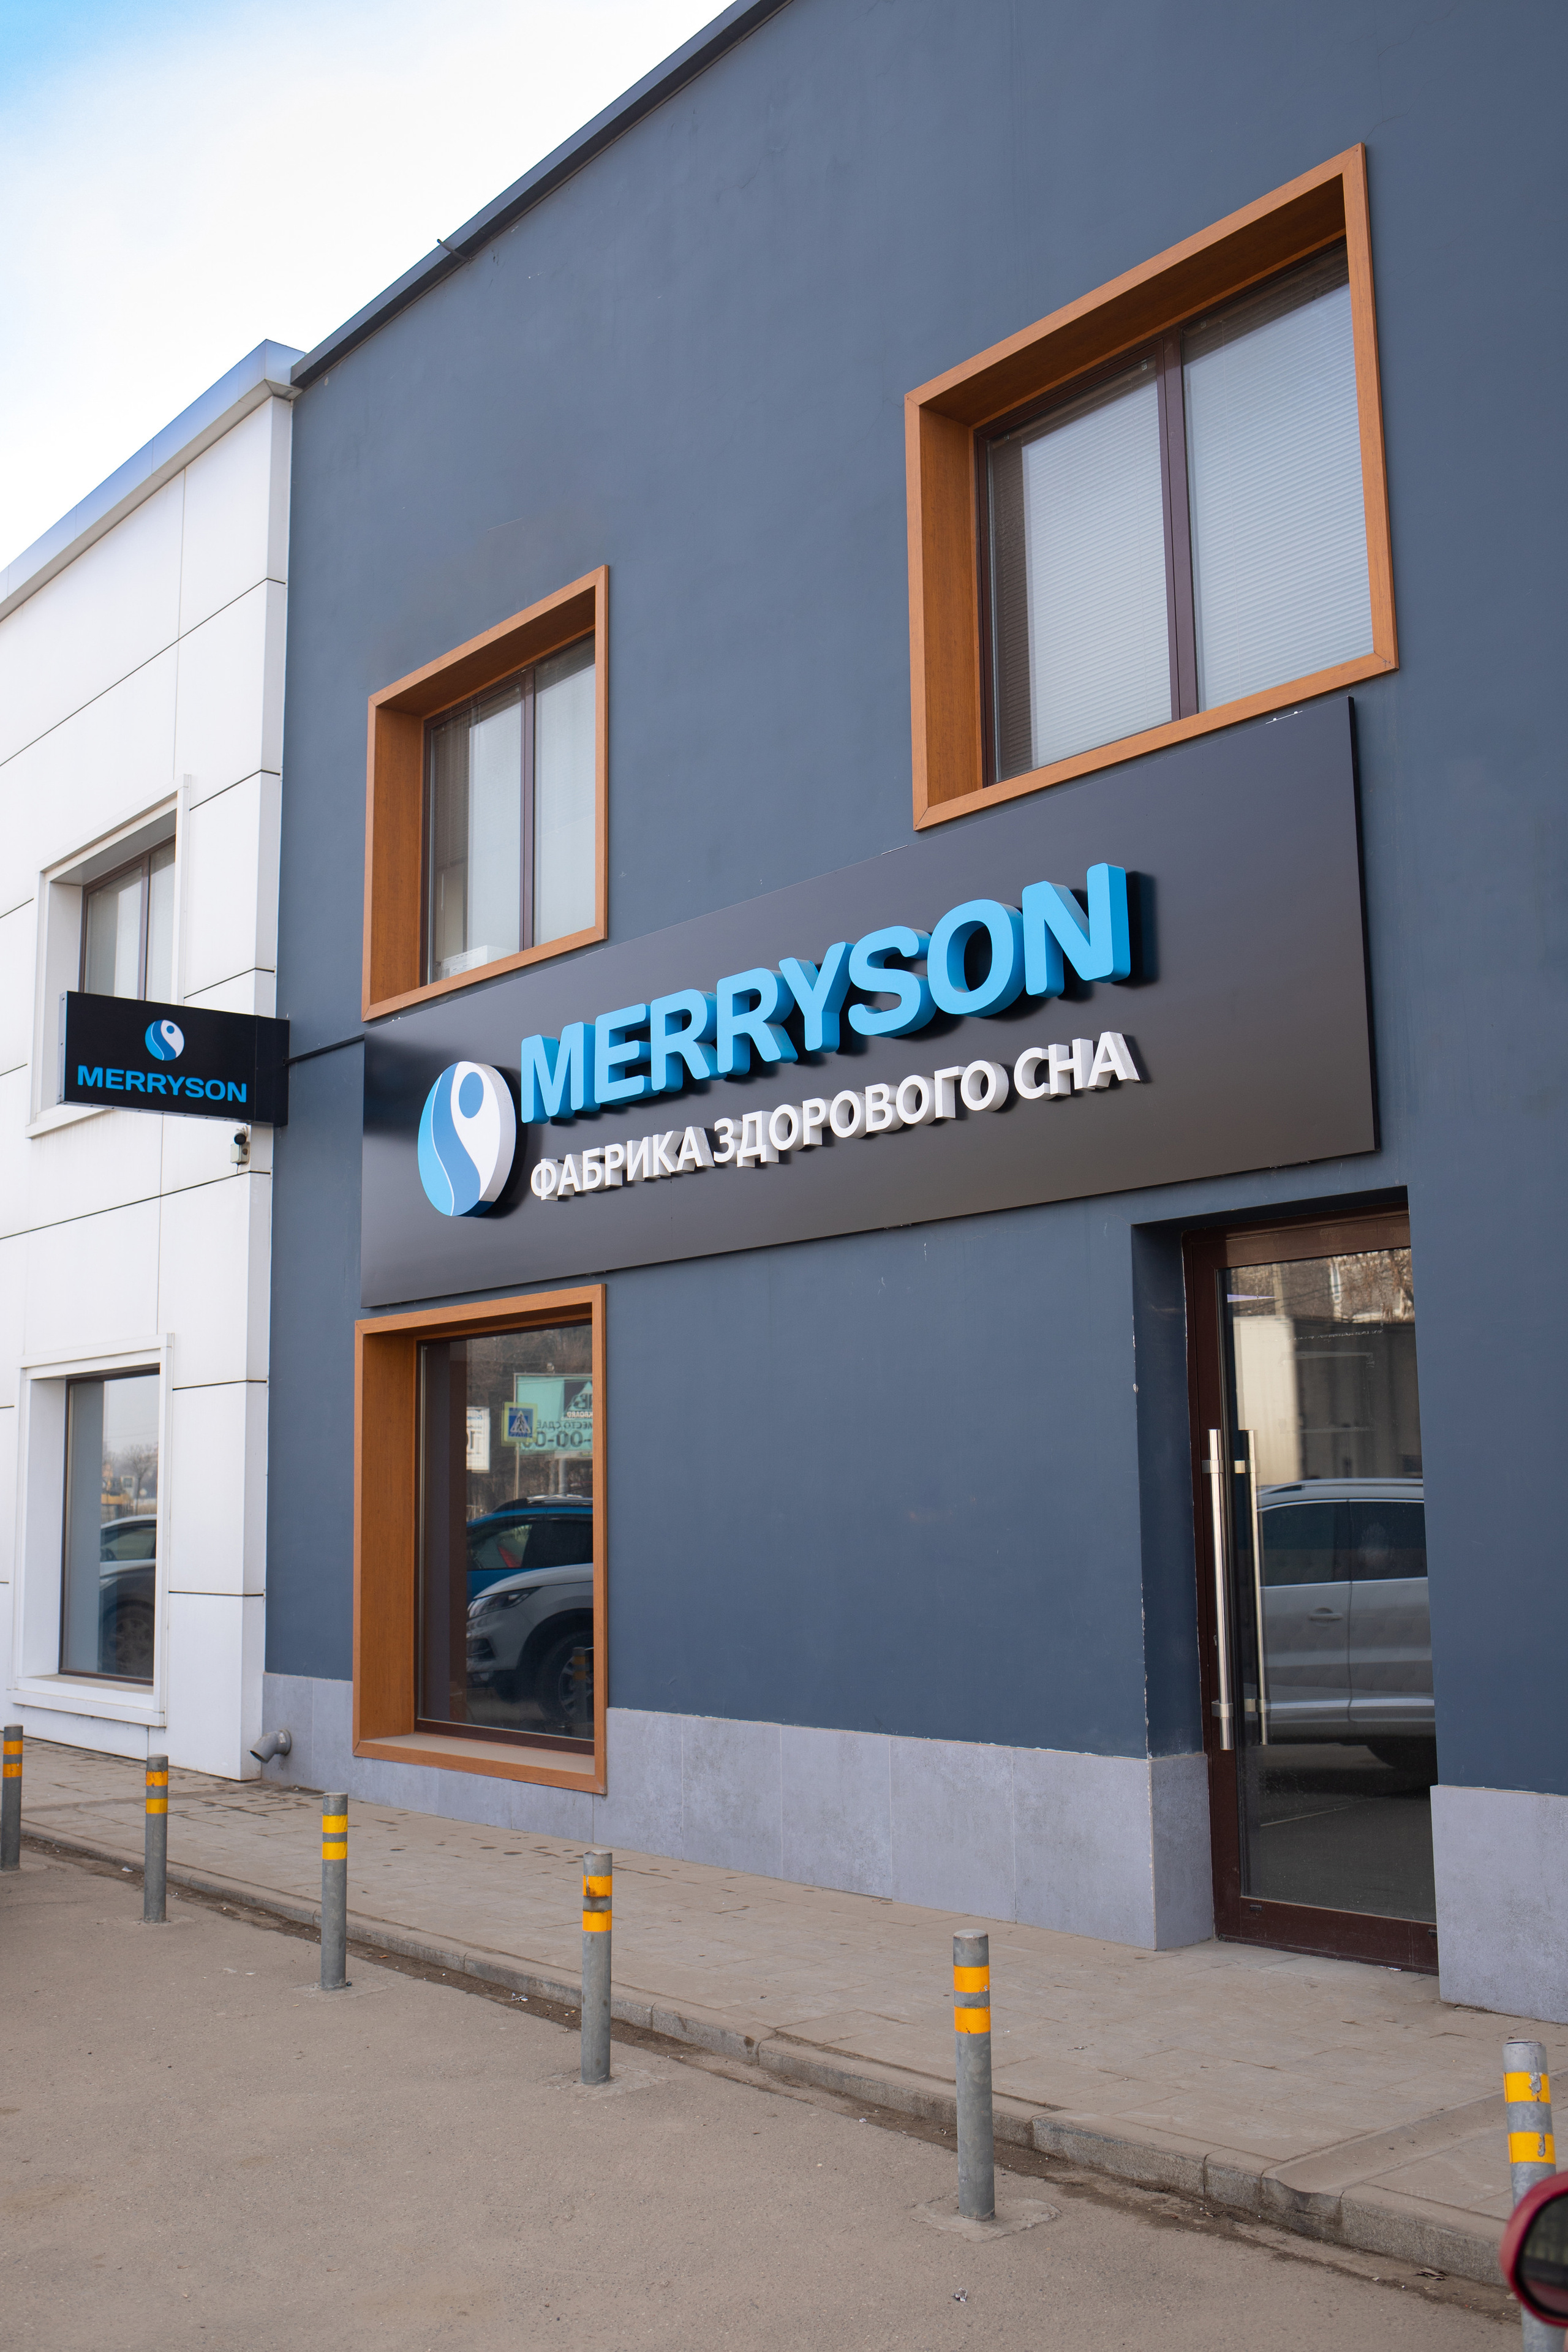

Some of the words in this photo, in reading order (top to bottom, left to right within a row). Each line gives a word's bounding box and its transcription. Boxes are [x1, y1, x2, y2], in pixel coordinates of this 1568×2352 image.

[521, 863, 1131, 1125] MERRYSON
[77, 1065, 247, 1103] MERRYSON
[530, 1126, 715, 1201] ФАБРИКА
[714, 1060, 1009, 1167] ЗДОРОВОГО
[1014, 1031, 1140, 1101] СНА
